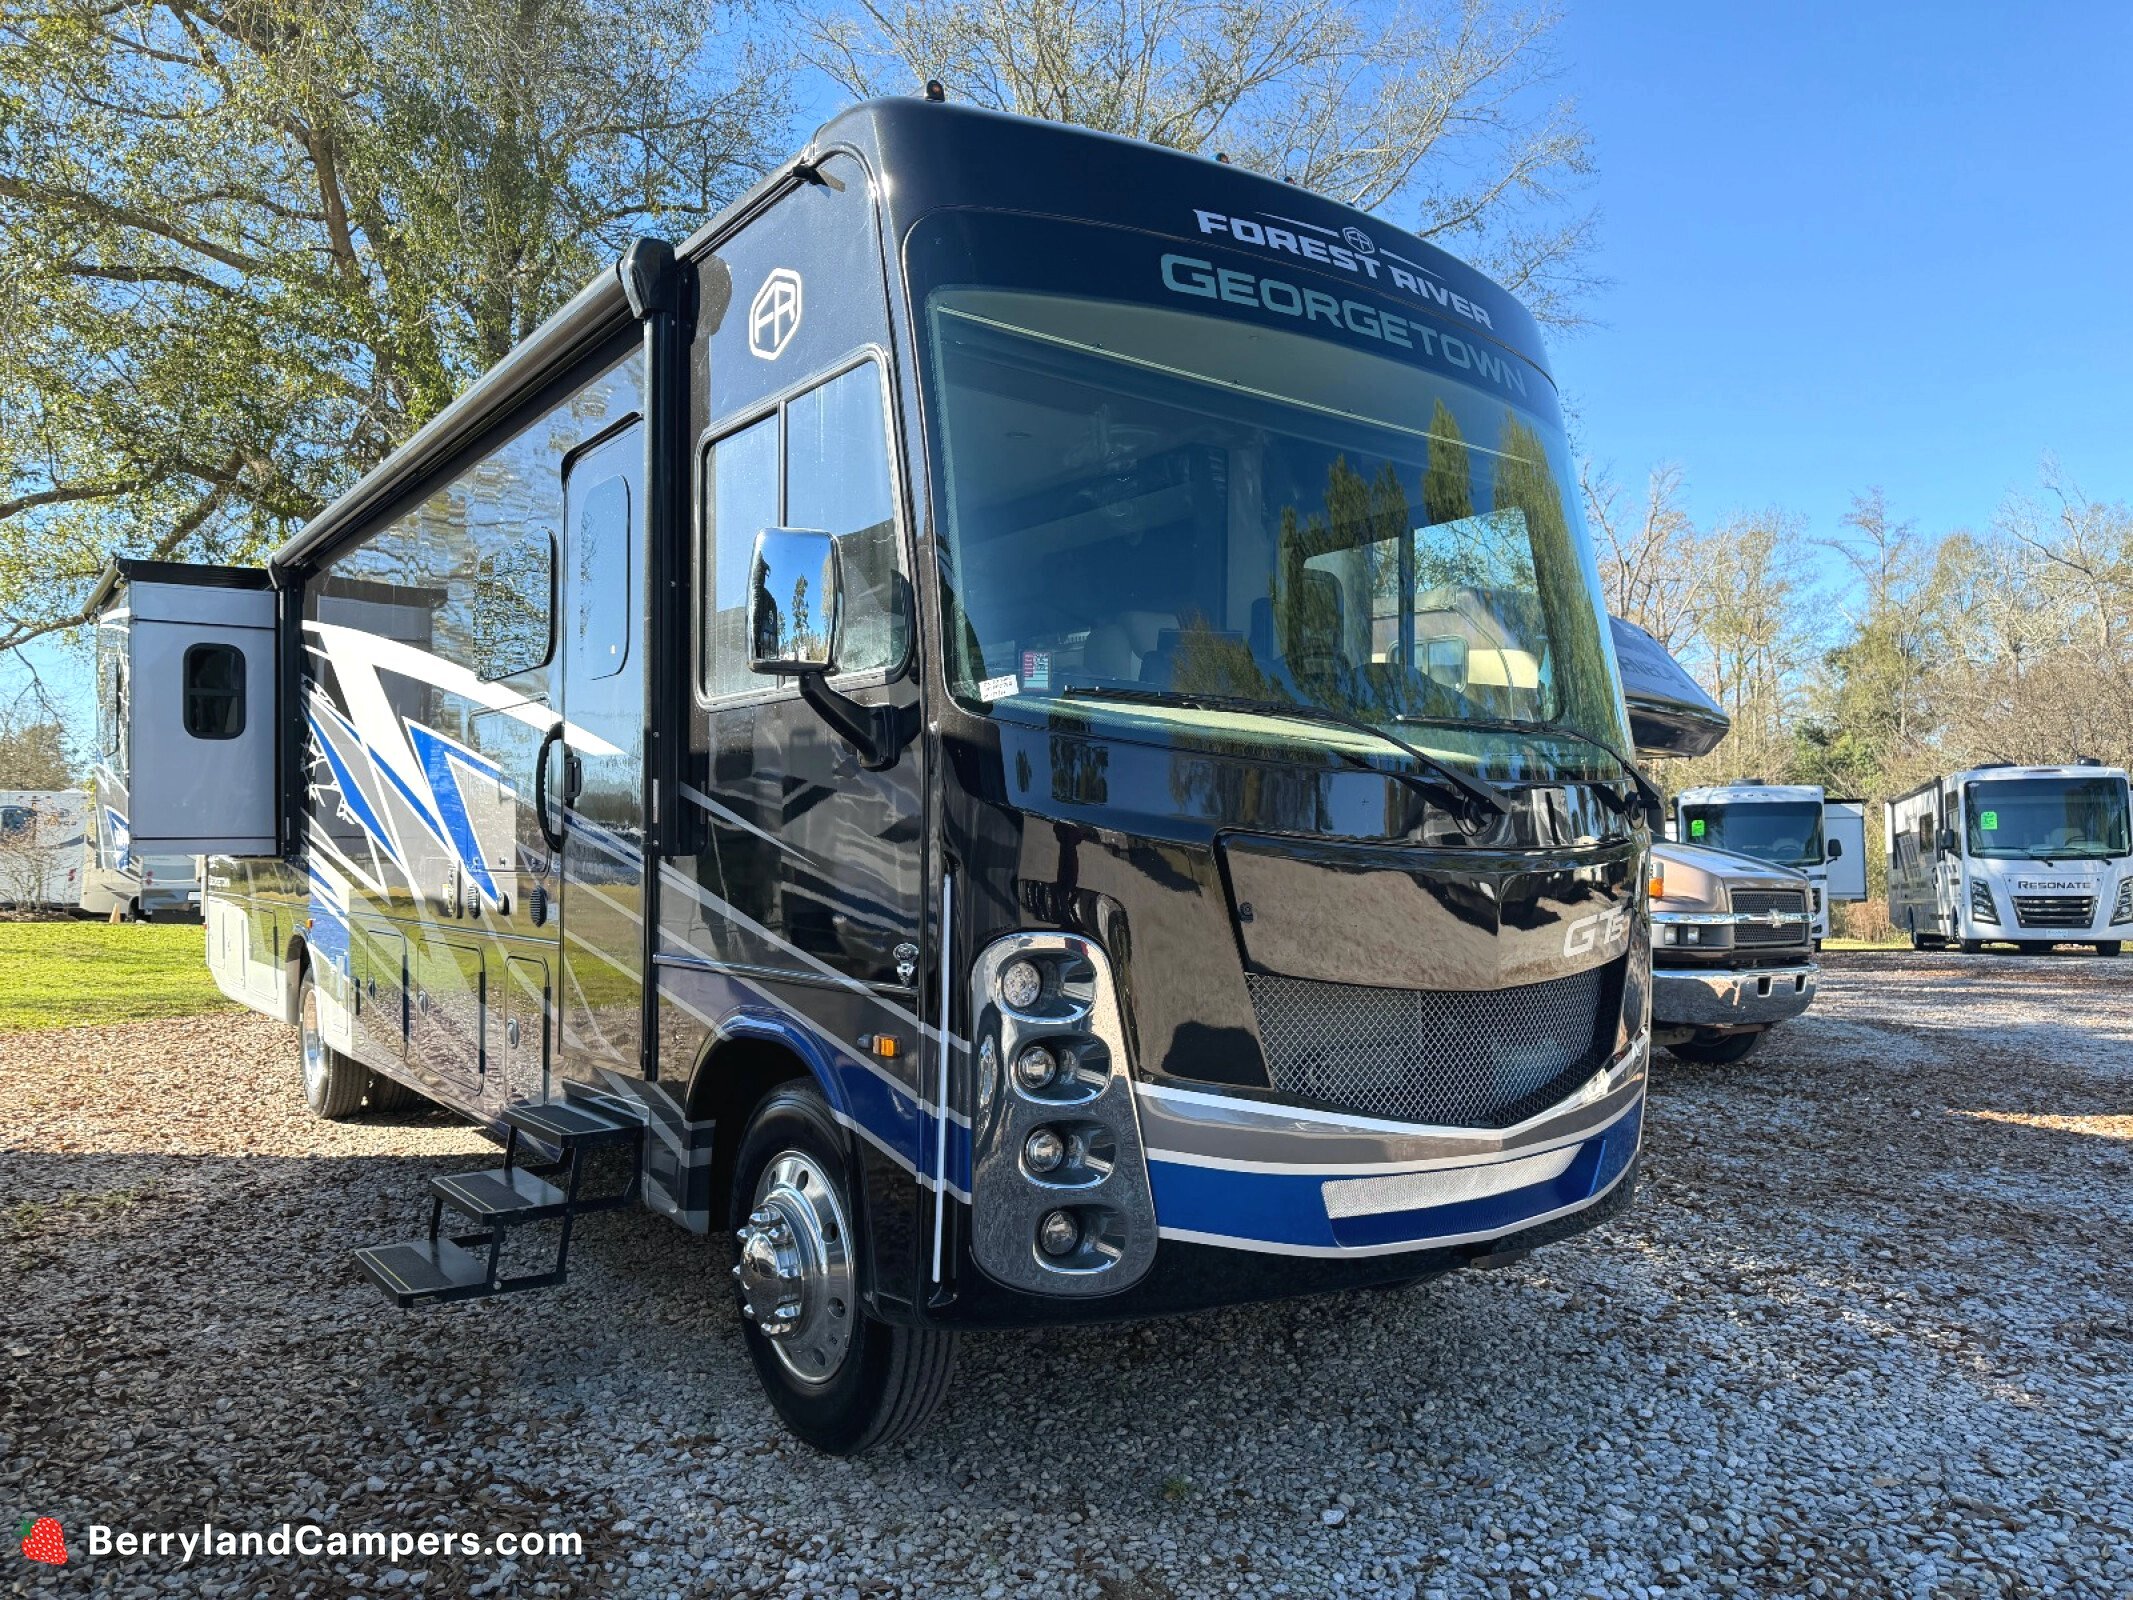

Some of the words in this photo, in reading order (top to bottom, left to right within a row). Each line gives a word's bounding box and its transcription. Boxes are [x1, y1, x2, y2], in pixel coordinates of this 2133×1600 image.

[1161, 253, 1527, 398] GEORGETOWN
[1193, 209, 1381, 279] FOREST
[1387, 264, 1494, 330] RIVER
[2017, 880, 2092, 889] RESONATE
